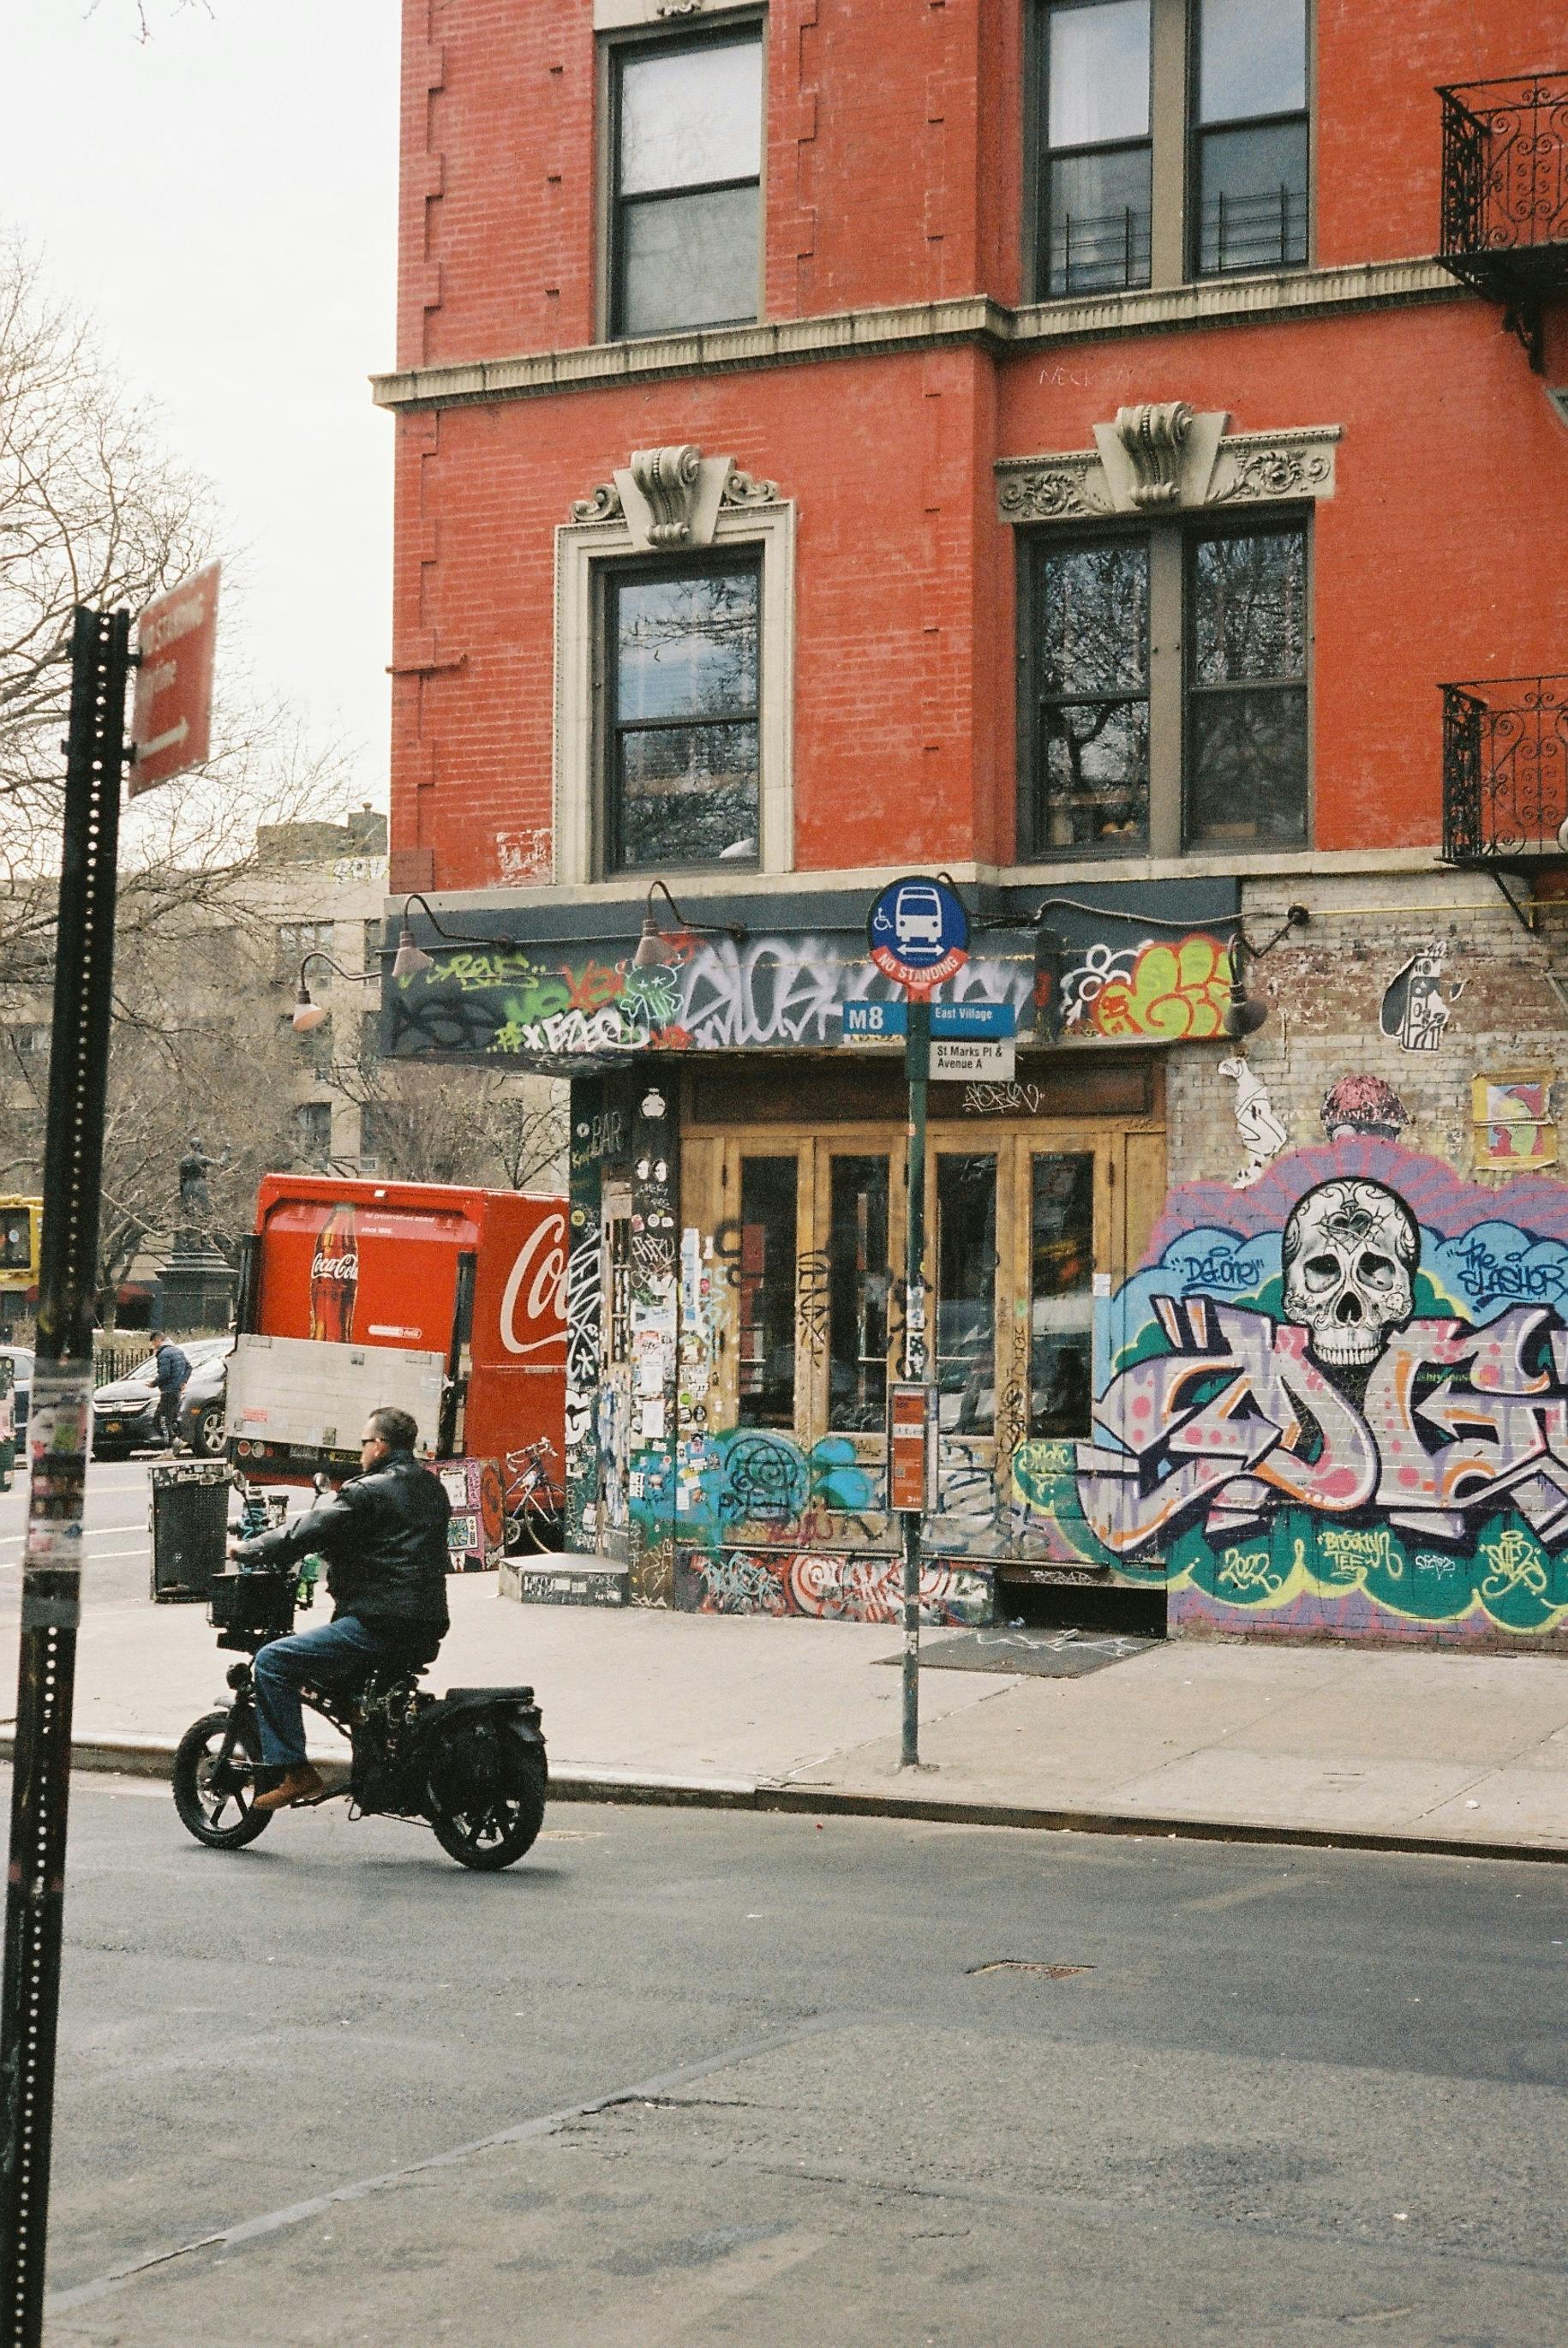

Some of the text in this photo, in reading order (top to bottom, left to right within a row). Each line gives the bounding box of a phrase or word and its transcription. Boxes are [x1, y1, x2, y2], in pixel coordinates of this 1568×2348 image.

[878, 953, 958, 982] NO STANDING
[849, 1006, 884, 1030] M8
[935, 1006, 993, 1021] East Village
[937, 1045, 1002, 1057] St Marks Pl &
[937, 1057, 983, 1069] Avenue A
